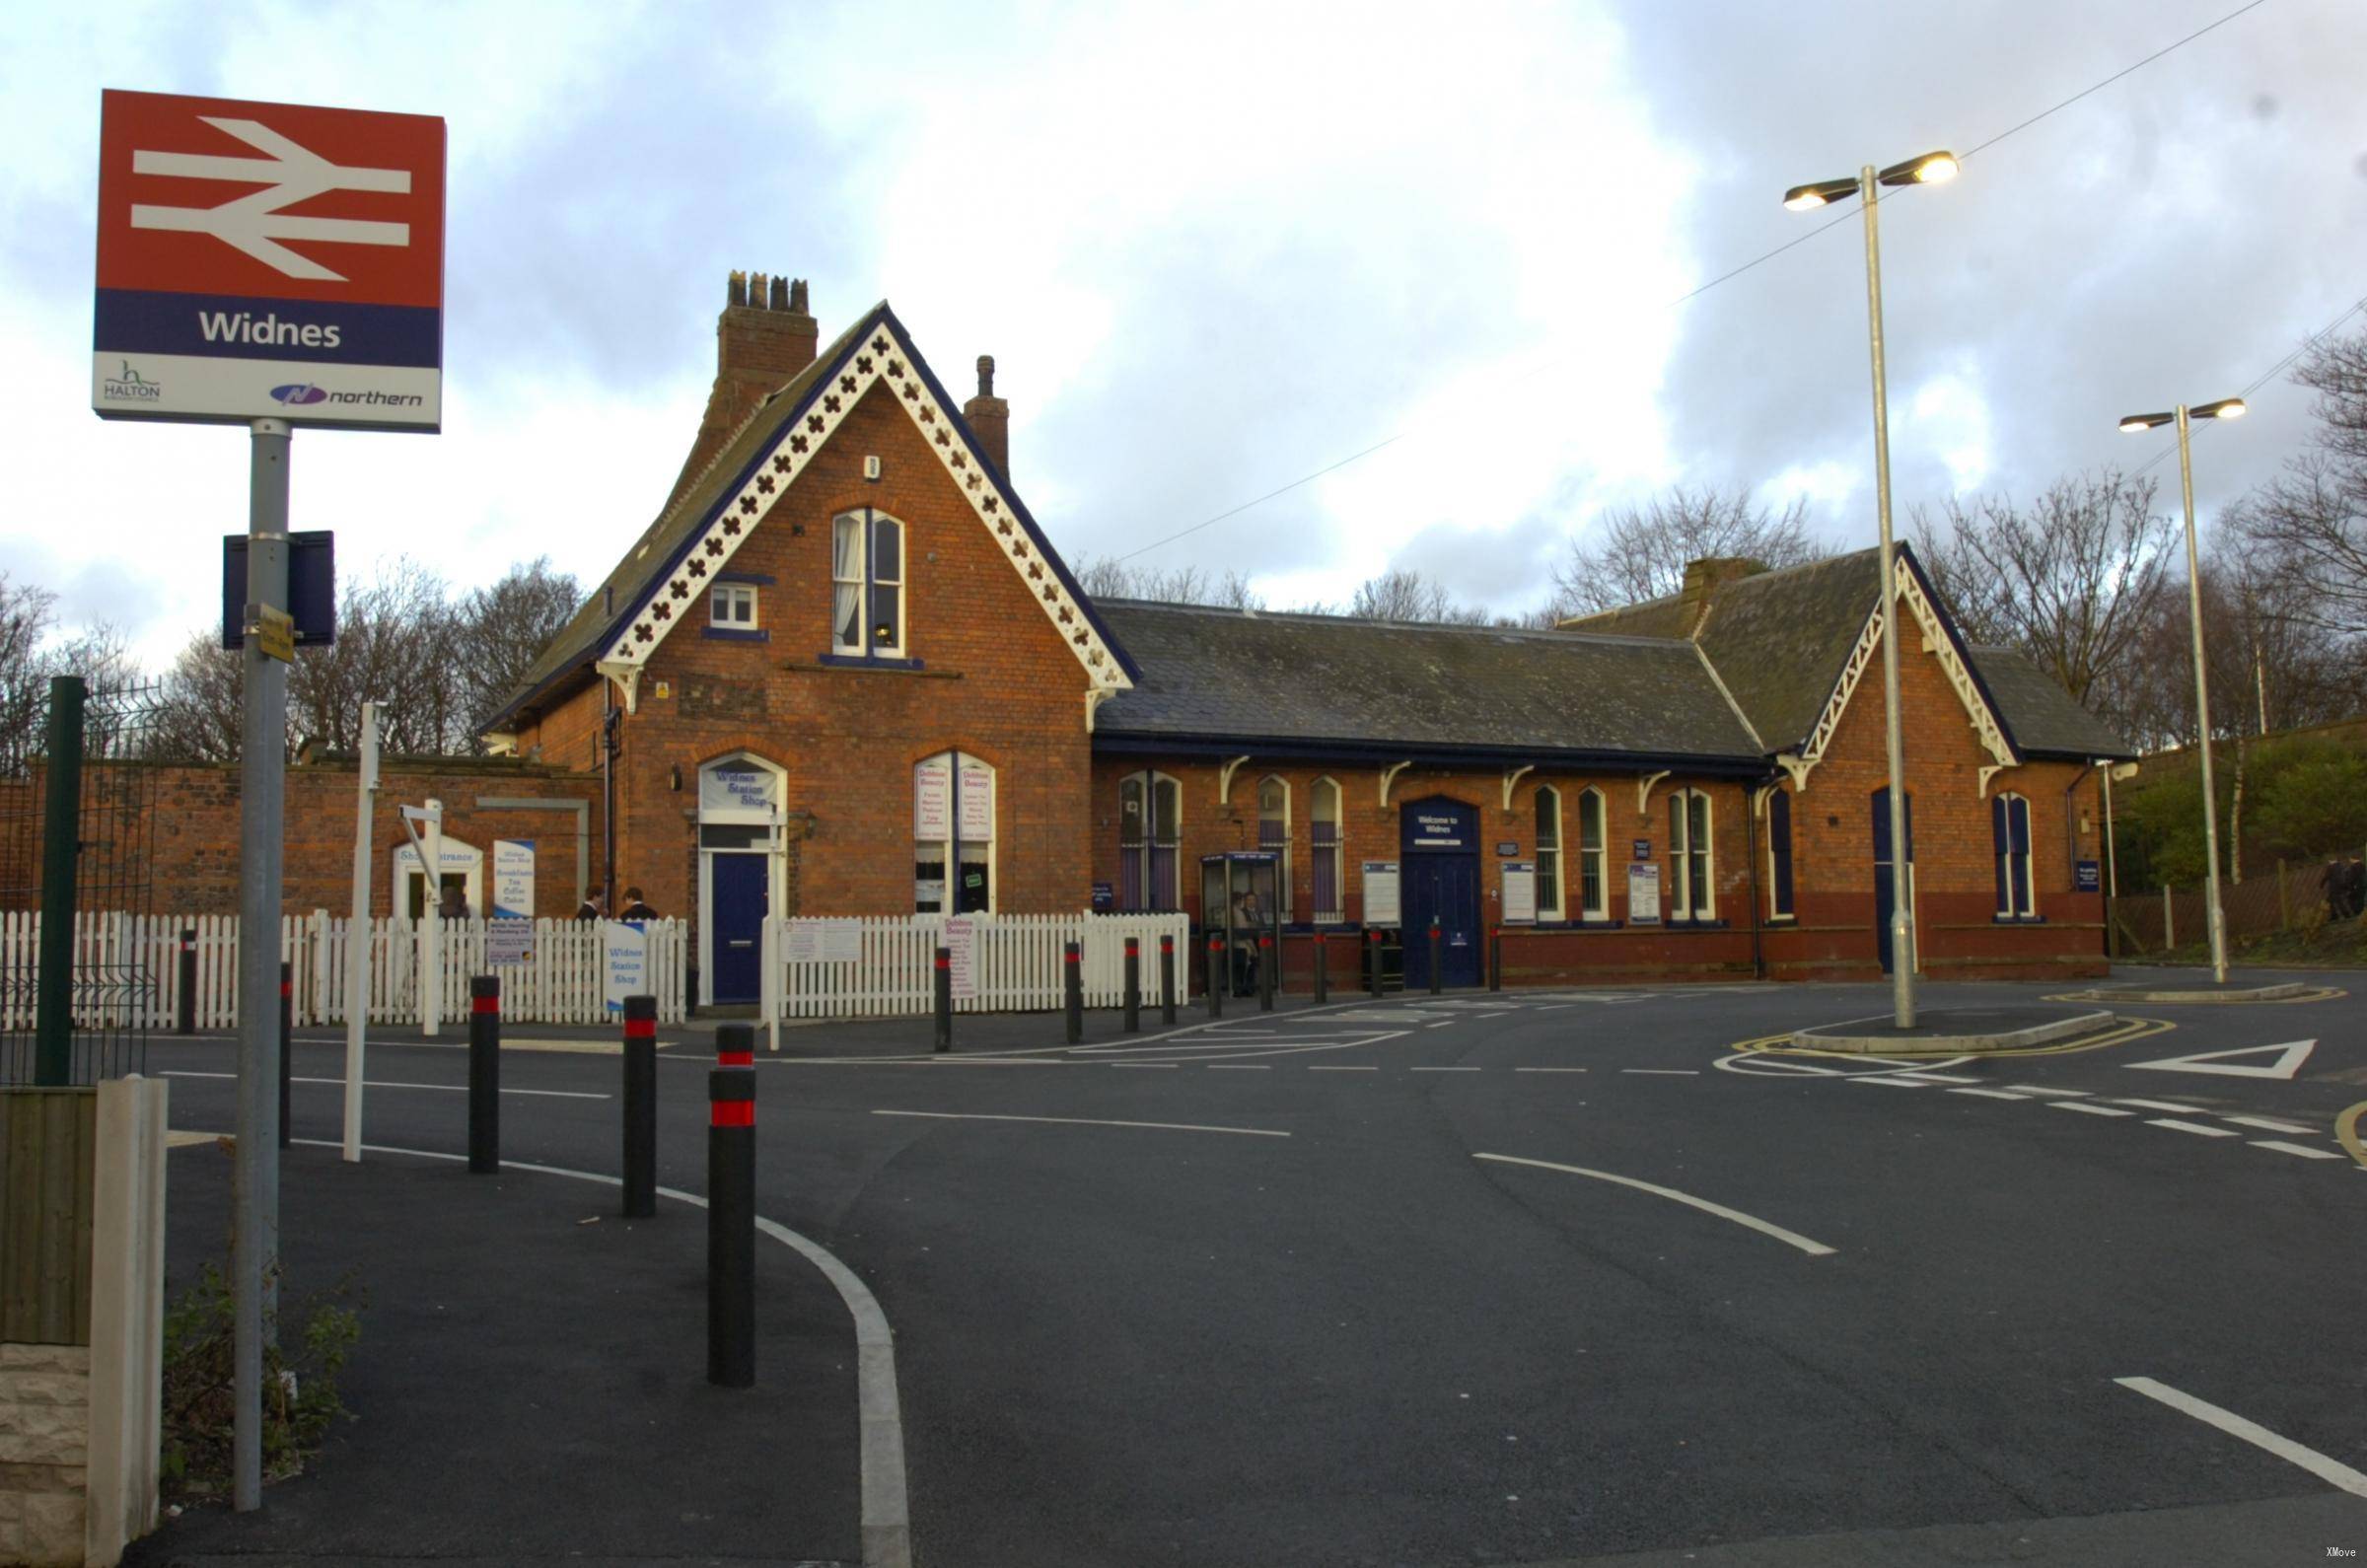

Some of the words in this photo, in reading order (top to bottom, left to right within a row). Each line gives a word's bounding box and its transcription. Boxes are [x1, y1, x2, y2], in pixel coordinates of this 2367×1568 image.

[199, 312, 340, 347] Widnes
[105, 386, 160, 396] HALTON
[329, 391, 423, 406] northern
[716, 768, 756, 782] Widnes
[728, 783, 763, 794] Station
[742, 795, 767, 807] Shop
[1418, 816, 1449, 824] Welcome
[1425, 824, 1451, 833] Widnes
[504, 887, 526, 895] Coffee
[946, 927, 972, 936] Beauty
[609, 948, 644, 957] Widnes
[610, 962, 642, 970] Station
[614, 974, 638, 985] Shop
